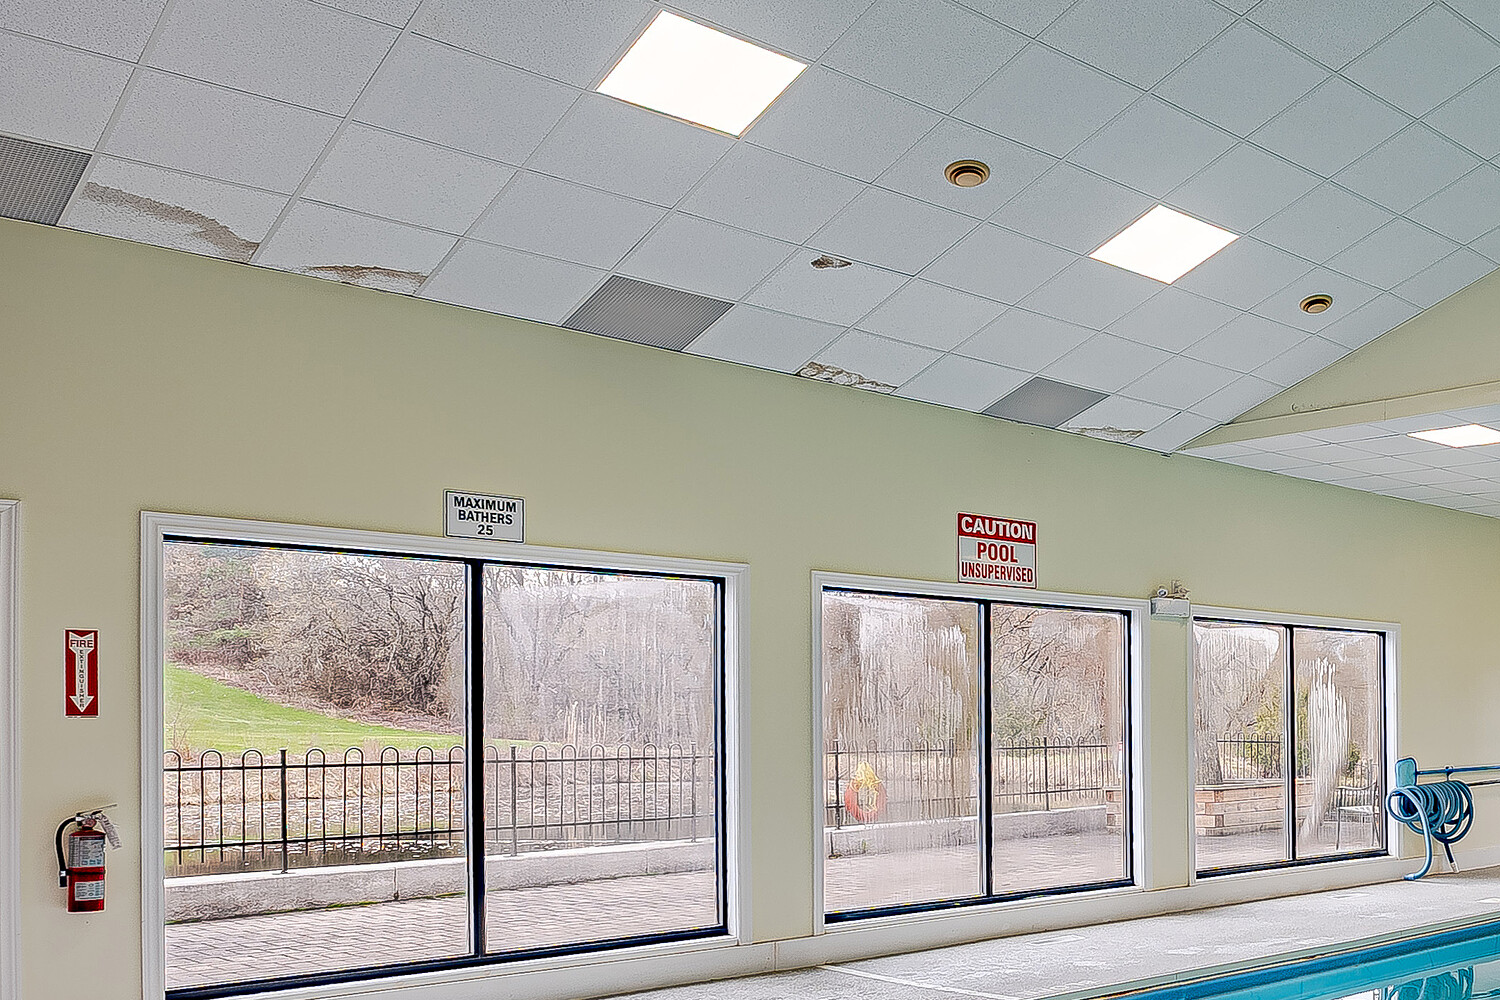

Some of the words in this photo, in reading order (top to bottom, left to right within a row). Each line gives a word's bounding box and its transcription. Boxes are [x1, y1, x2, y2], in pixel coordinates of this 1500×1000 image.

[454, 496, 516, 512] MAXIMUM
[458, 510, 512, 524] BATHERS
[478, 524, 493, 536] 25
[962, 516, 1033, 540] CAUTION
[977, 542, 1018, 563] POOL
[962, 562, 1033, 582] UNSUPERVISED
[70, 640, 94, 648] FIRE
